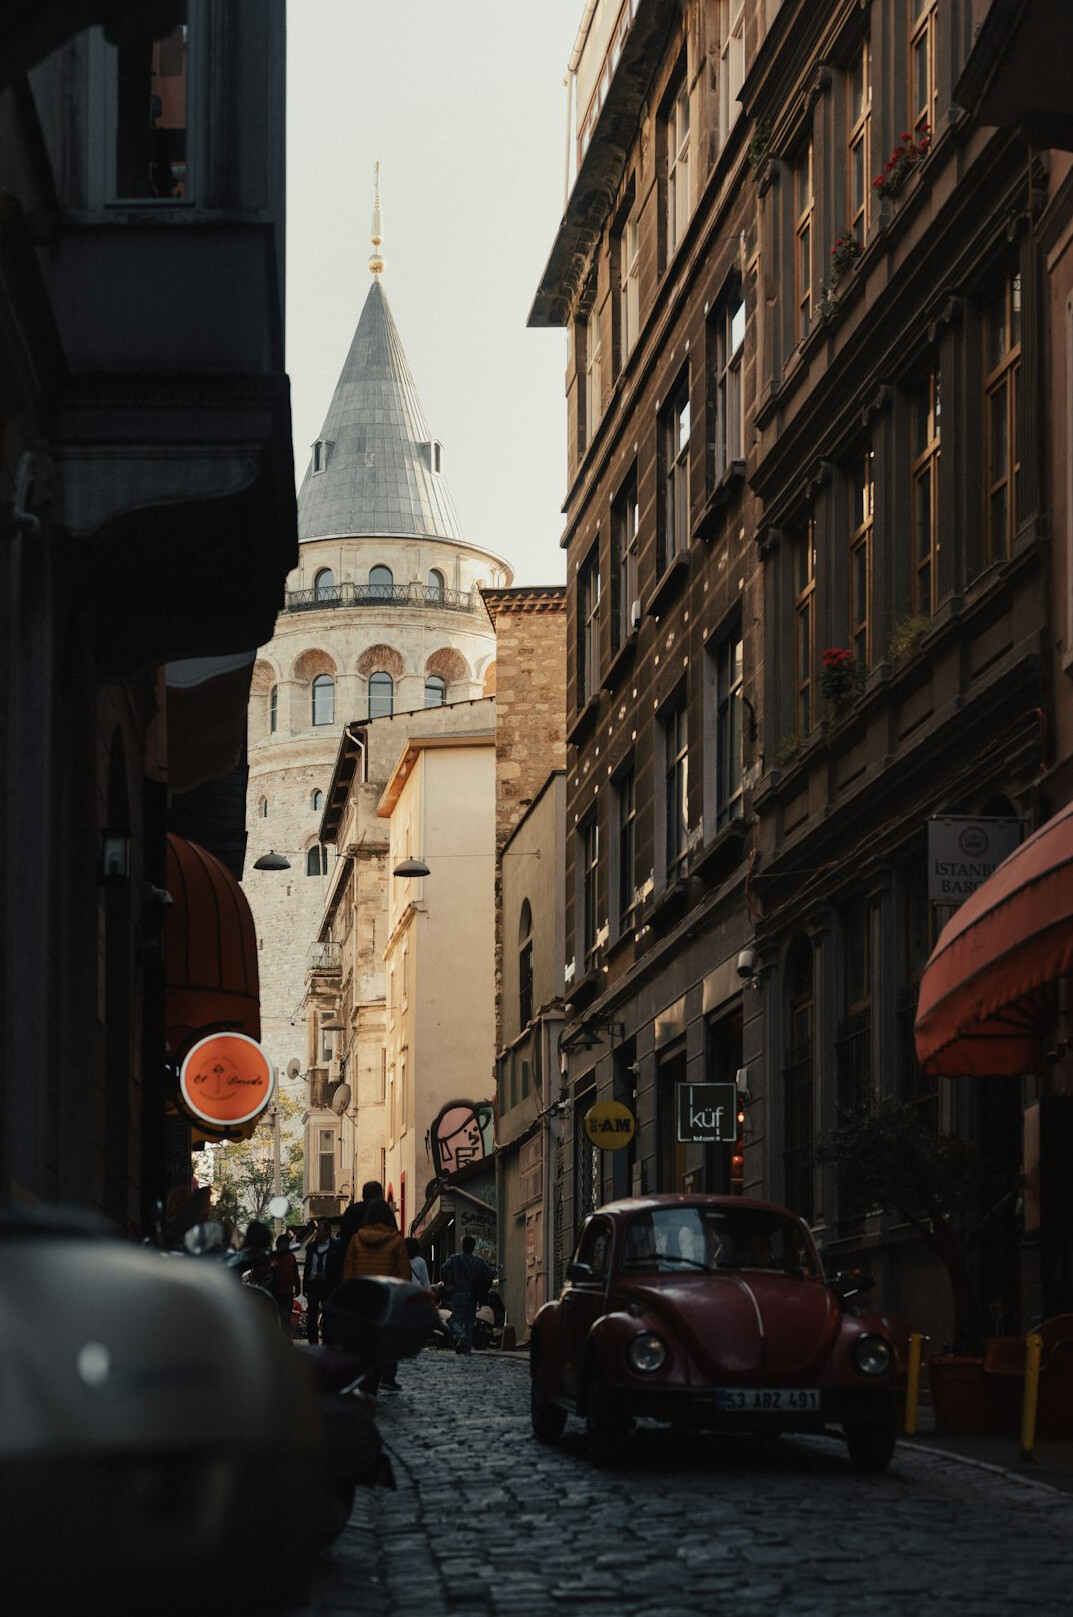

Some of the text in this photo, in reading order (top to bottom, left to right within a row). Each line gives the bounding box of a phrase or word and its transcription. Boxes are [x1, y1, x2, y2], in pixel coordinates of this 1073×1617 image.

[727, 1391, 816, 1409] 53 ABZ 491
